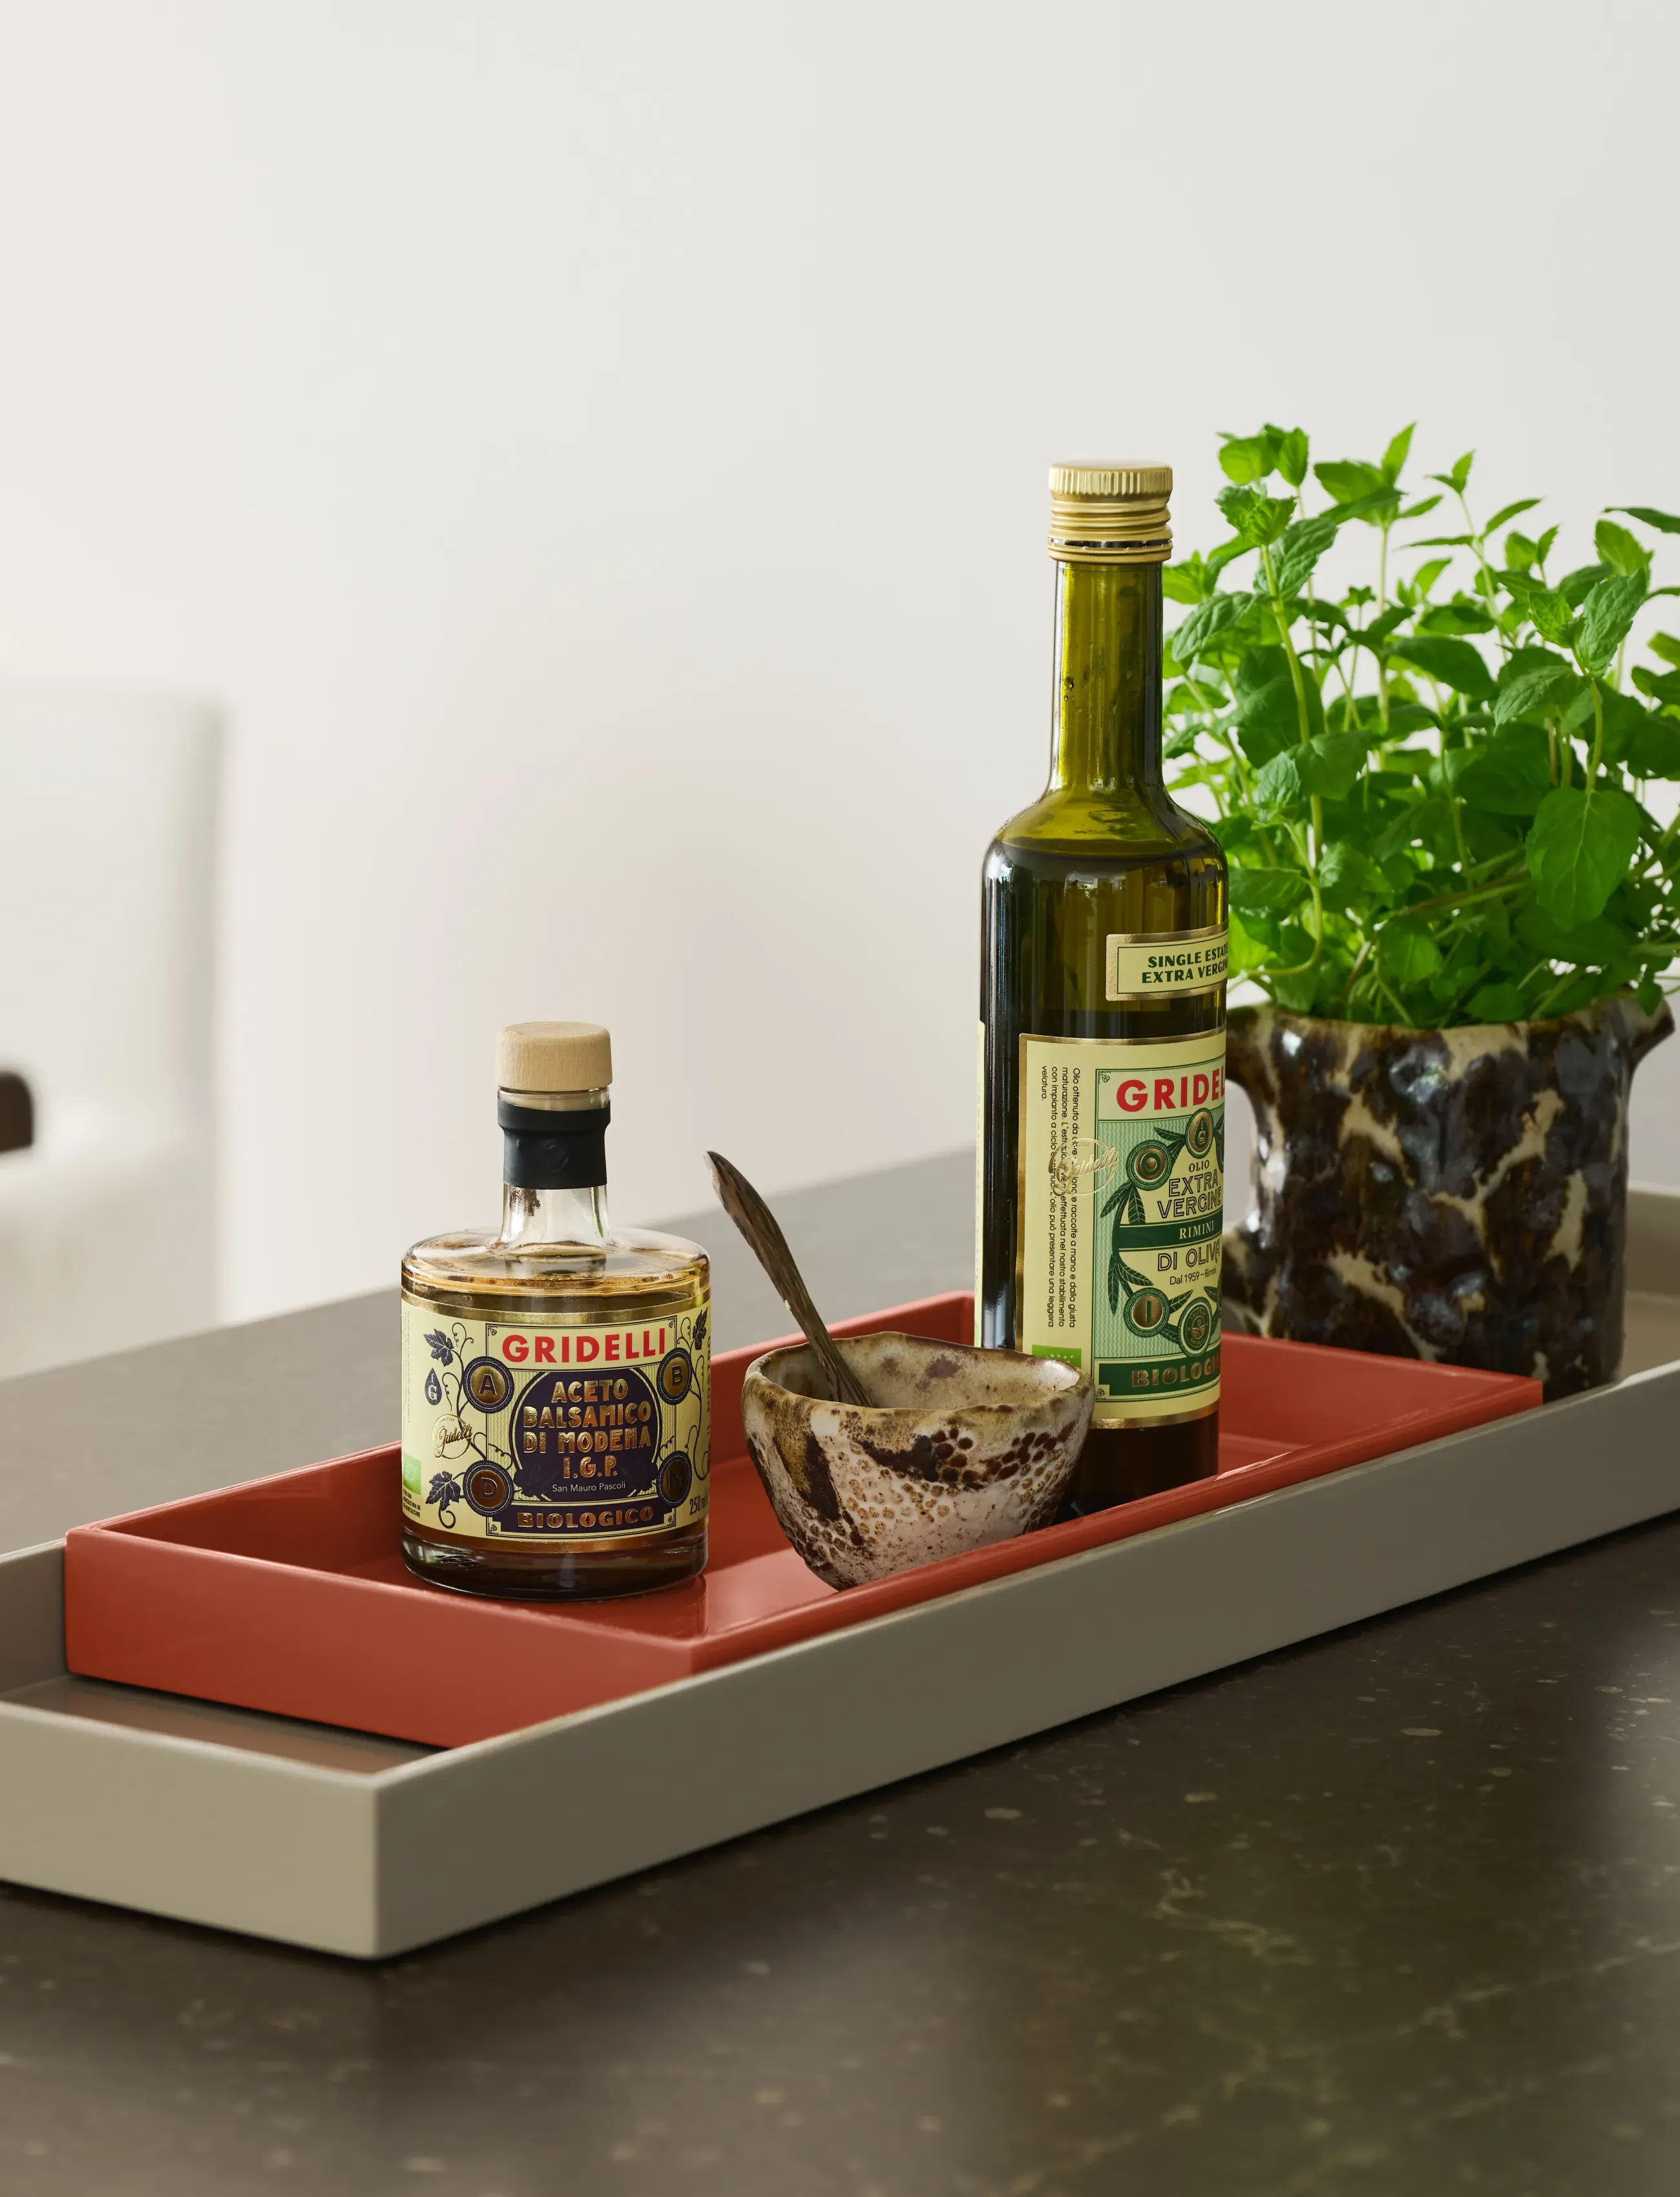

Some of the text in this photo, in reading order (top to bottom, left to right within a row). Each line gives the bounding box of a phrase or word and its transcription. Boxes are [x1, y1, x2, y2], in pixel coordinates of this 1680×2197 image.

[1148, 951, 1201, 968] SINGLE
[1142, 969, 1193, 983] EXTRA
[1072, 1123, 1079, 1134] da
[1189, 1159, 1210, 1172] OLIO
[1169, 1169, 1218, 1197] EXTRA
[1157, 1186, 1221, 1219] VERGINE
[1179, 1220, 1214, 1239] RIMINI
[1158, 1239, 1220, 1272] DI OLIVA
[1170, 1274, 1182, 1285] Dal
[1047, 1296, 1055, 1327] leggera
[1068, 1304, 1076, 1327] giusta
[502, 1327, 665, 1363] GRIDELLI
[551, 1378, 628, 1403] ACETO
[523, 1400, 651, 1428] BALSAMICO
[523, 1425, 651, 1453] DI MODENA
[563, 1455, 618, 1478] I.G.P.
[570, 1484, 596, 1492] Mauro
[599, 1481, 625, 1491] Pascoli
[689, 1495, 700, 1515] 250
[518, 1506, 653, 1528] BIOLOGICO
